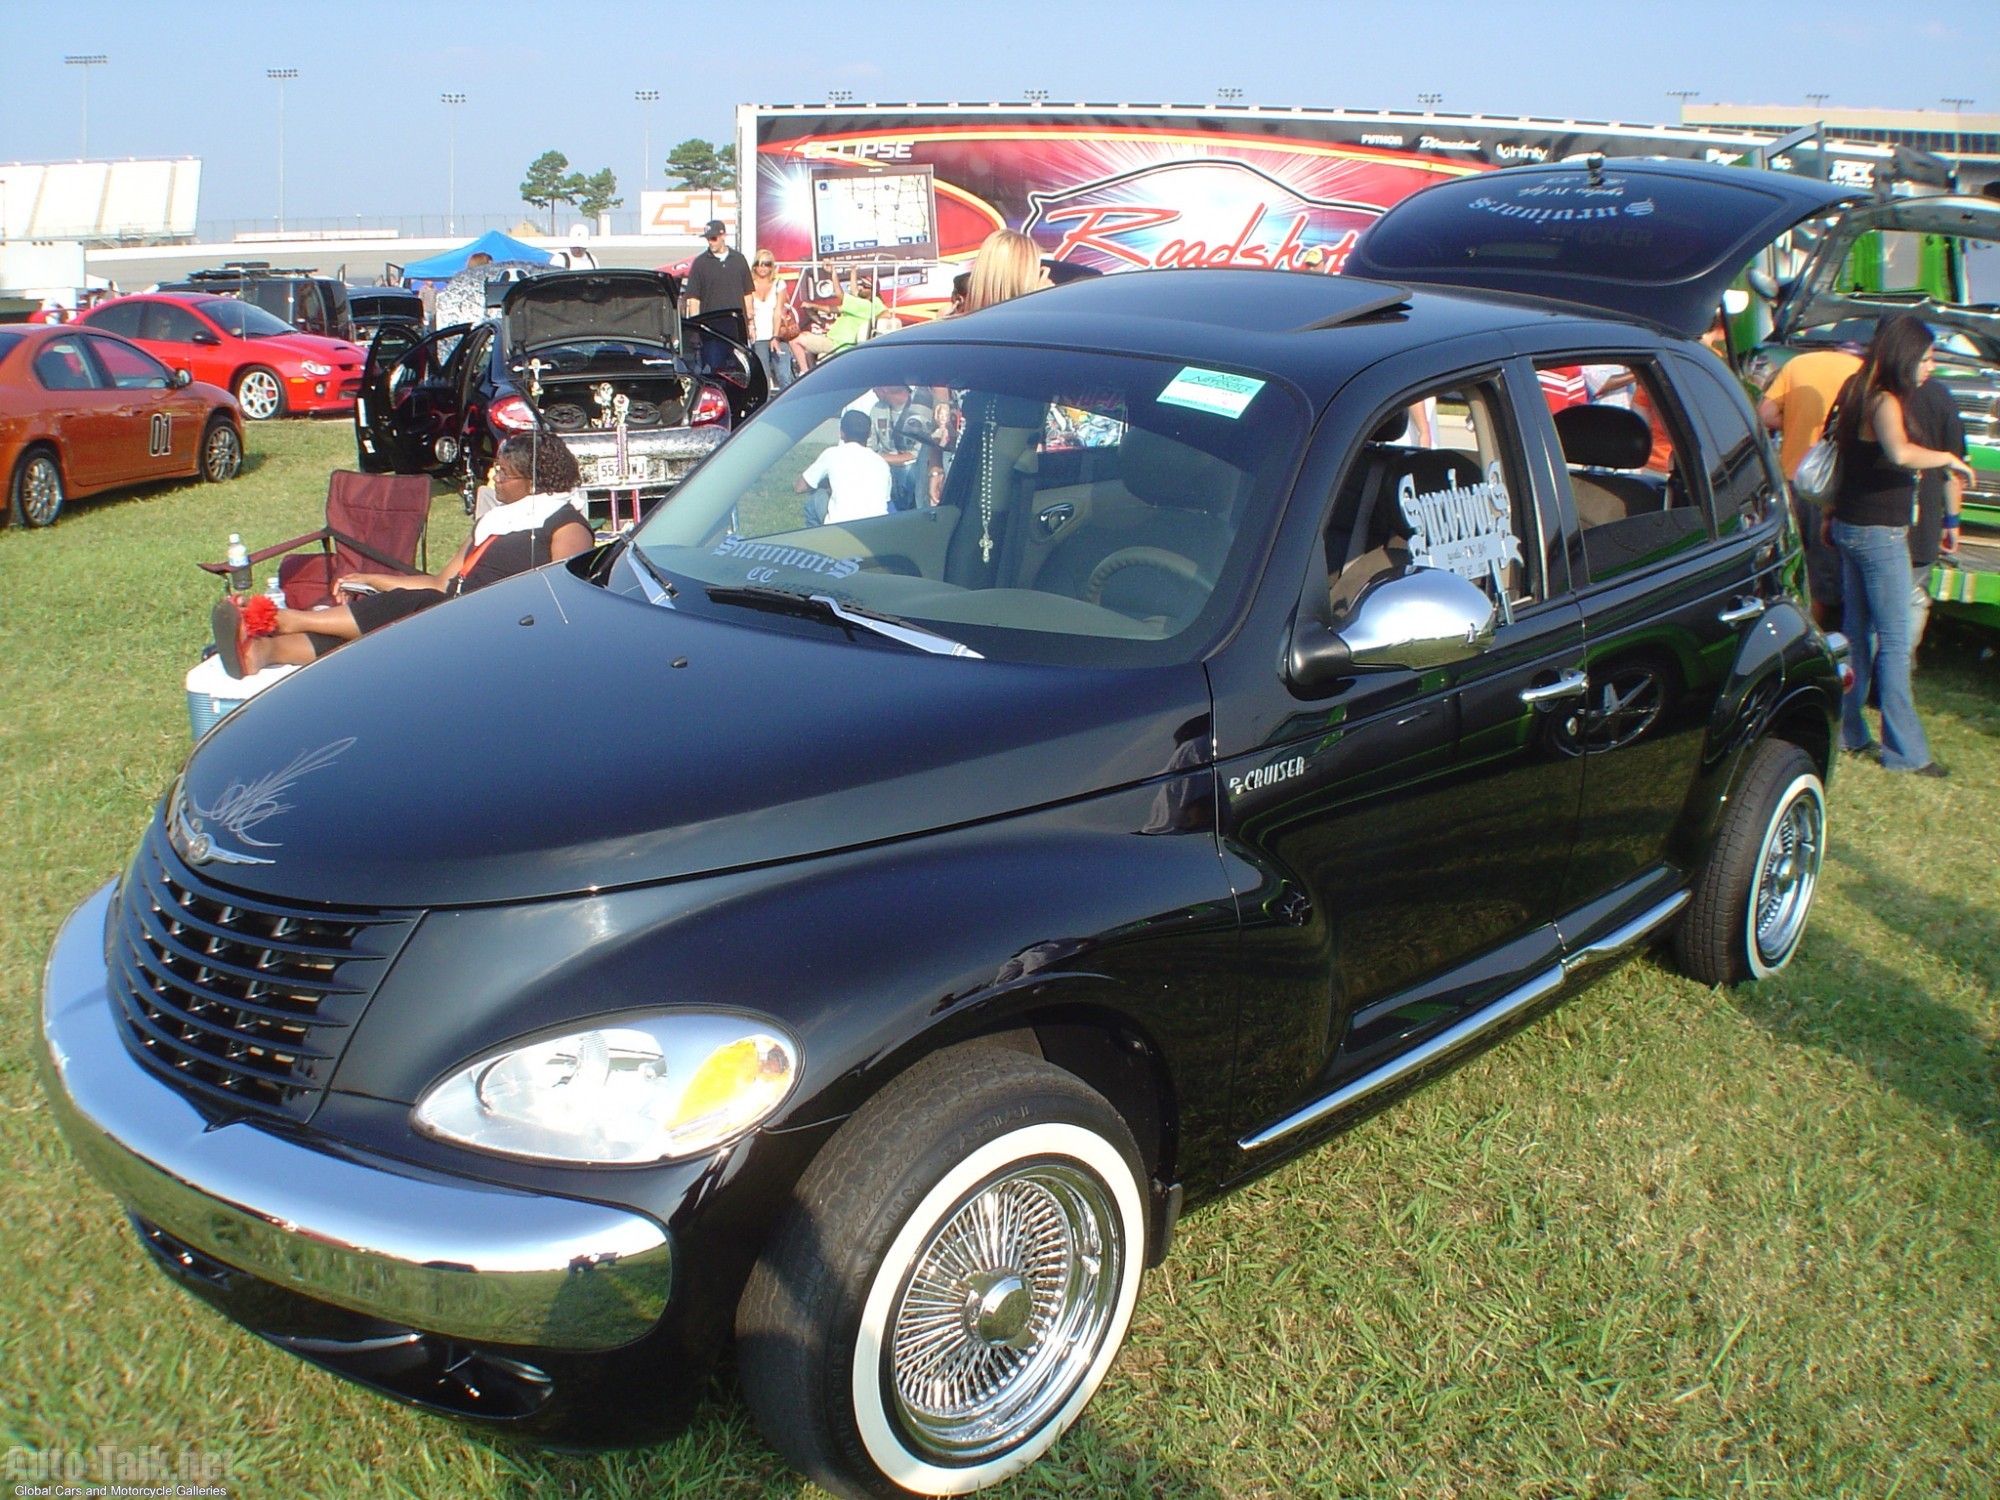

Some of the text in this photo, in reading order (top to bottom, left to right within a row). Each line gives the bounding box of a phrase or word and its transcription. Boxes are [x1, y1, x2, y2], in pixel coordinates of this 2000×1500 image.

[804, 141, 914, 159] ECLIPSE
[1361, 134, 1402, 146] PYTHON
[1046, 202, 1358, 276] Roadsht
[149, 412, 172, 457] 01
[746, 566, 779, 583] CC
[1244, 756, 1305, 791] CRUISER
